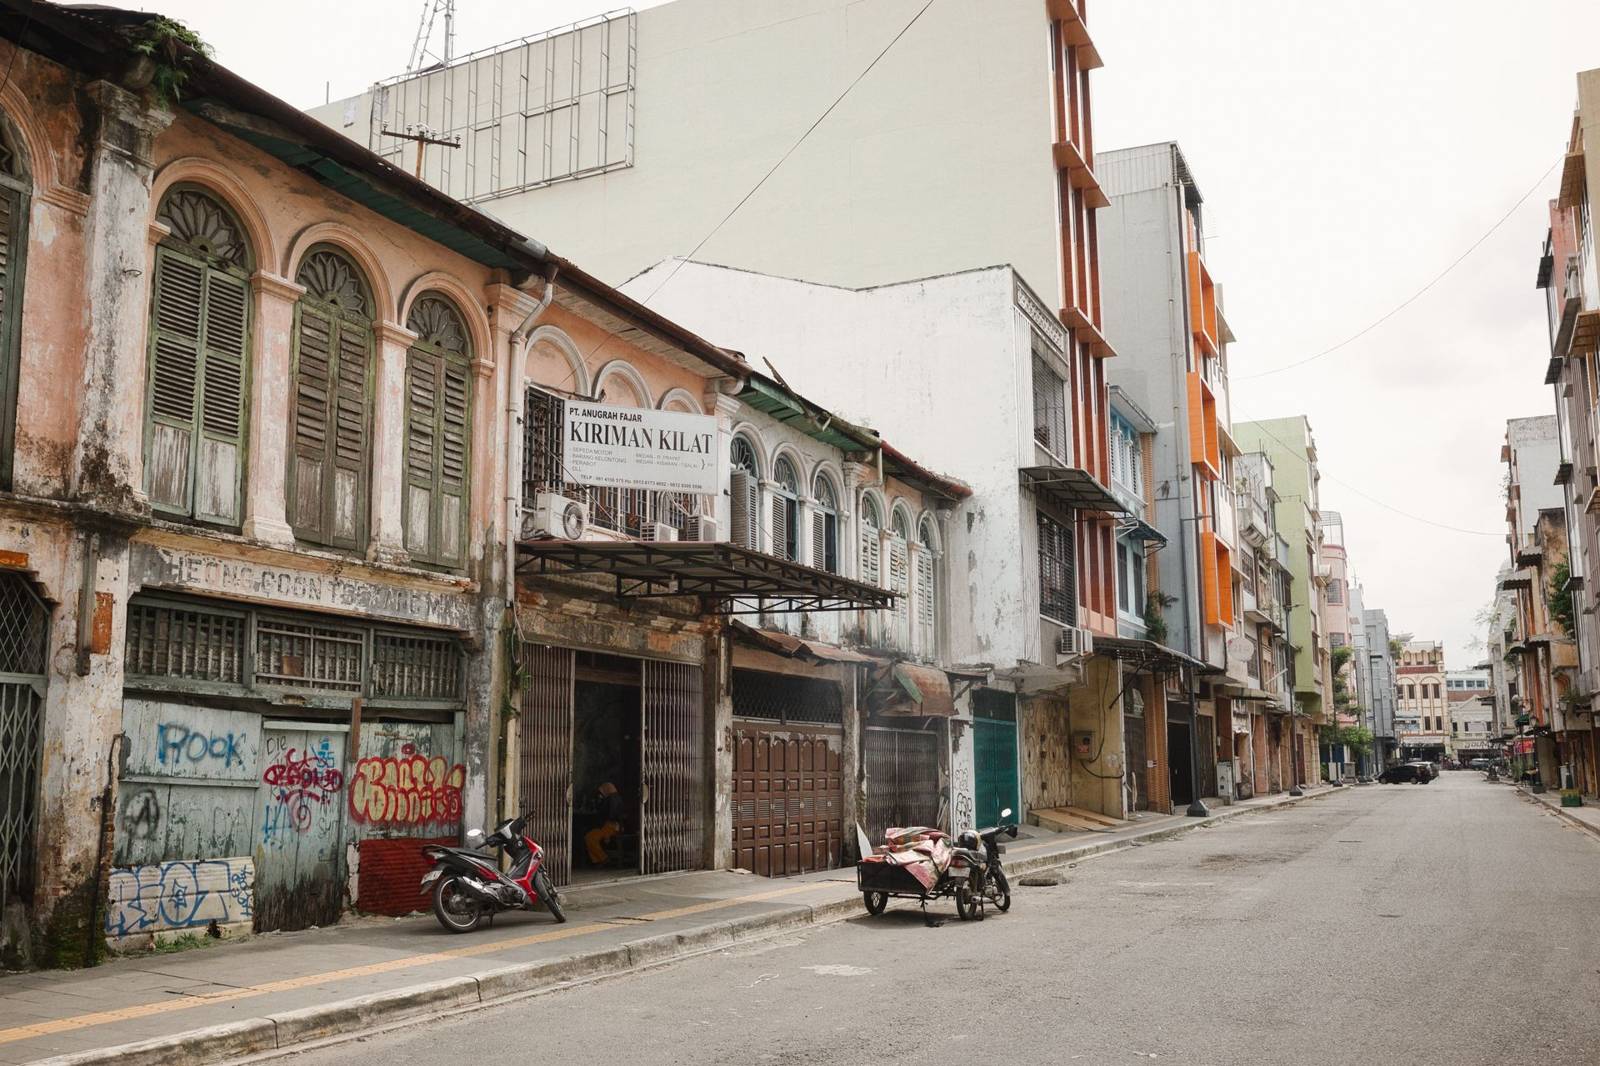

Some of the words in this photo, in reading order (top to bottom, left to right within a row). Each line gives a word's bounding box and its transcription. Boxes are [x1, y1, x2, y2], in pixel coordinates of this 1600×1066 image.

[569, 406, 580, 416] PT.
[581, 407, 617, 420] ANUGRAH
[619, 411, 642, 423] FAJAR
[570, 420, 652, 448] KIRIMAN
[659, 429, 712, 454] KILAT
